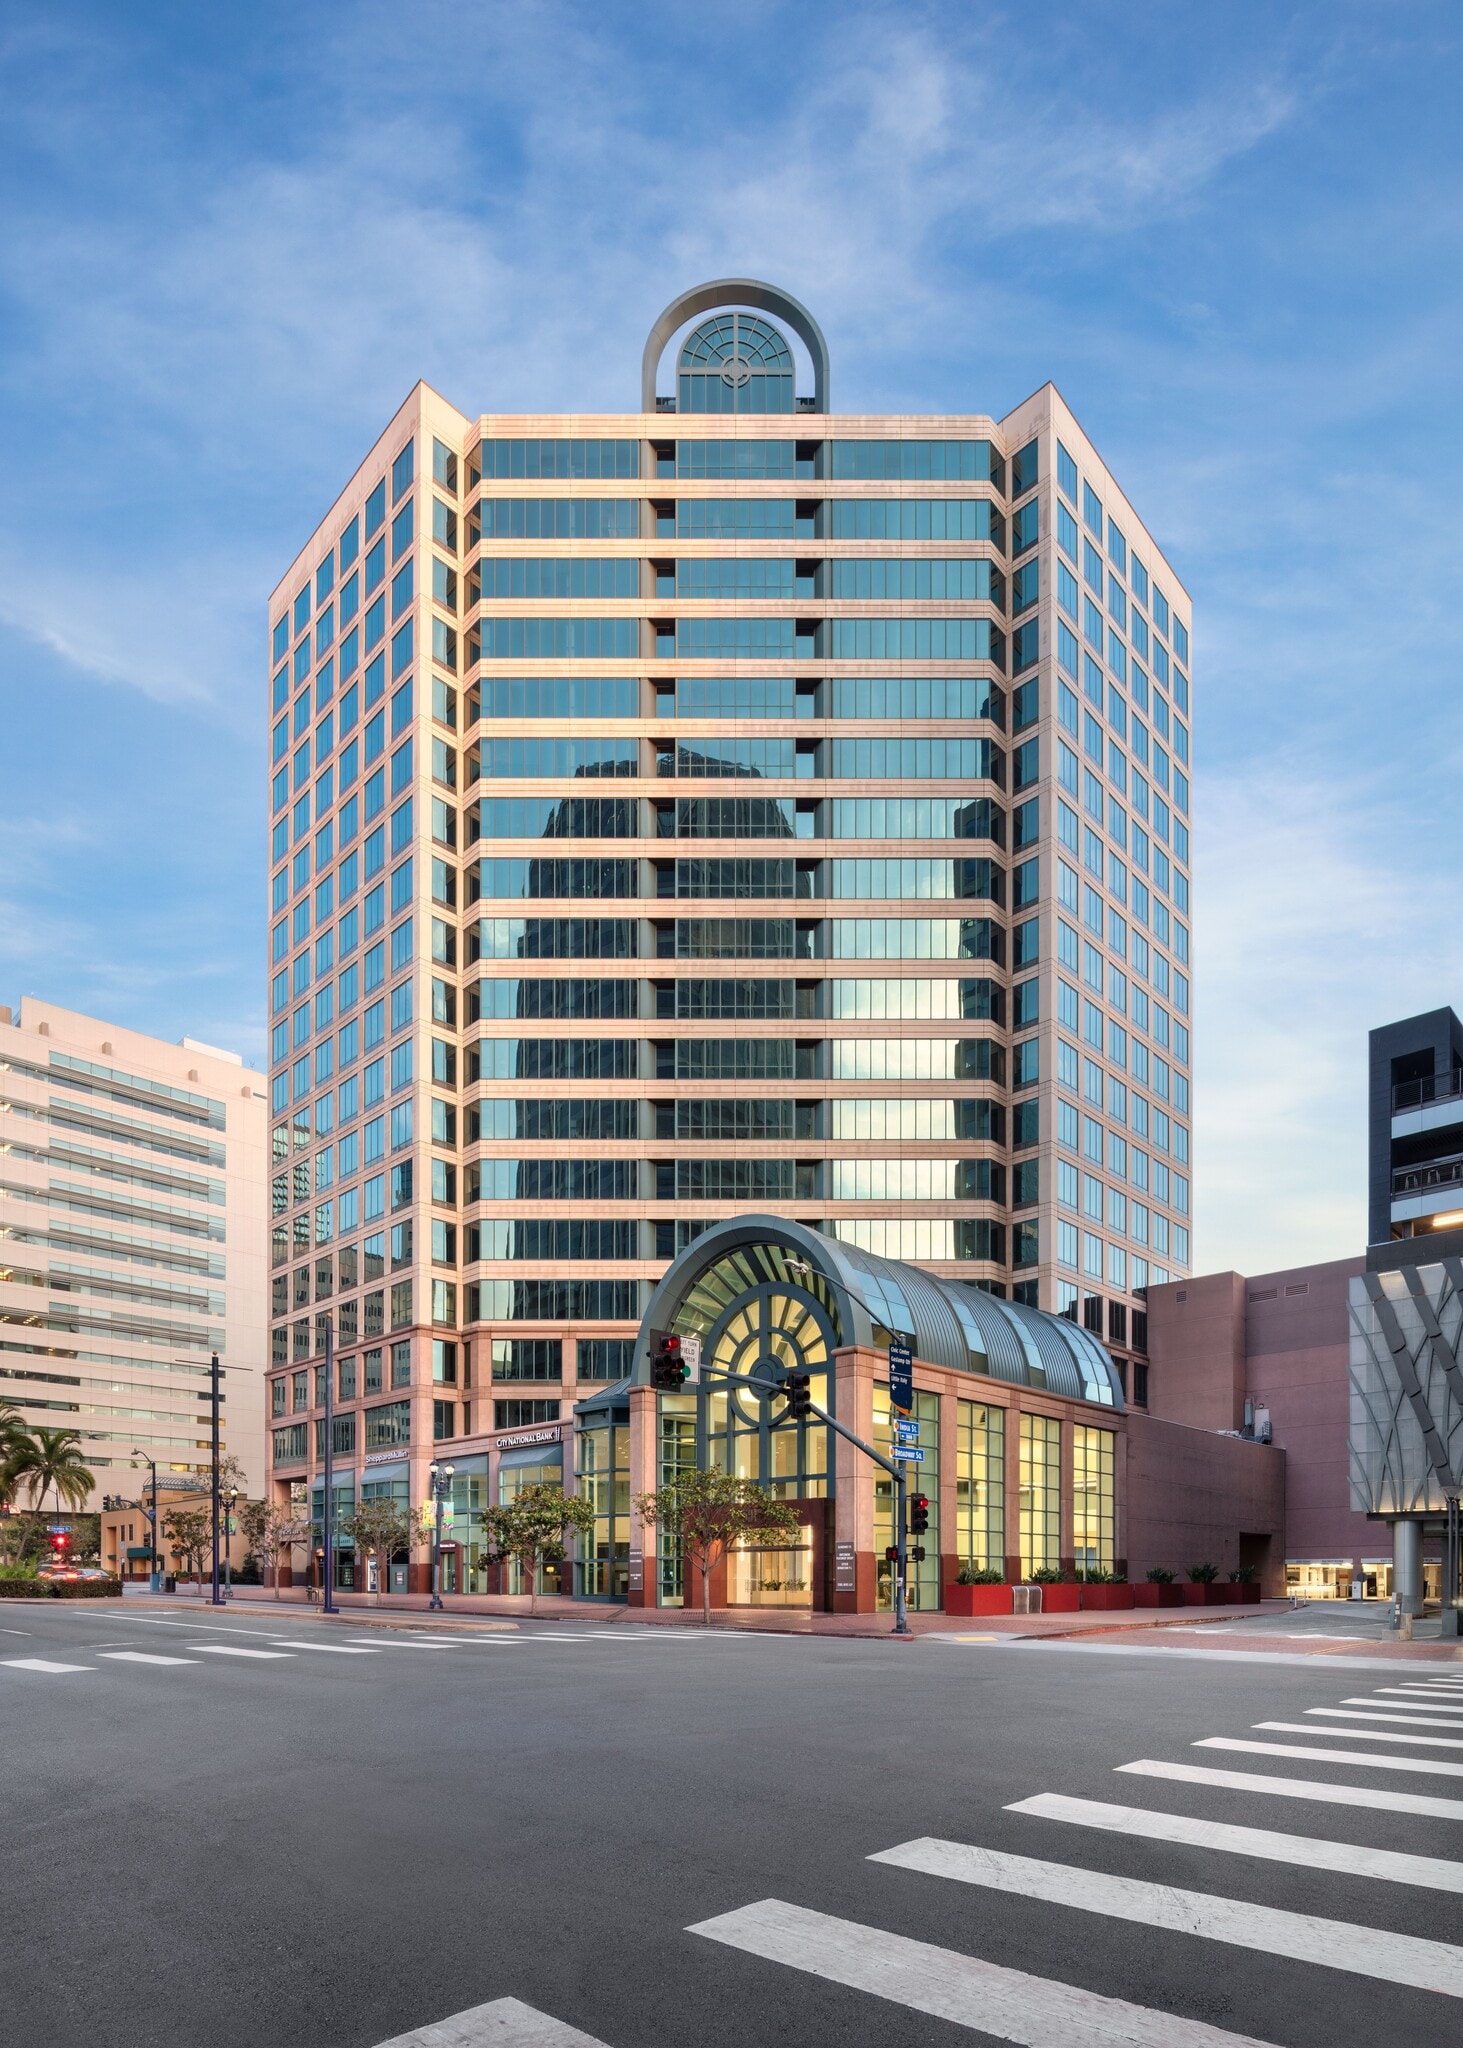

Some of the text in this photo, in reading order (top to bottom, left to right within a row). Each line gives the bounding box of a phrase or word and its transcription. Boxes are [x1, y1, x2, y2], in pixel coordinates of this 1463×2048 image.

[899, 1348, 910, 1356] Center
[496, 1432, 554, 1447] CITY NATIONAL BANK
[894, 1448, 915, 1458] BROADWAY
